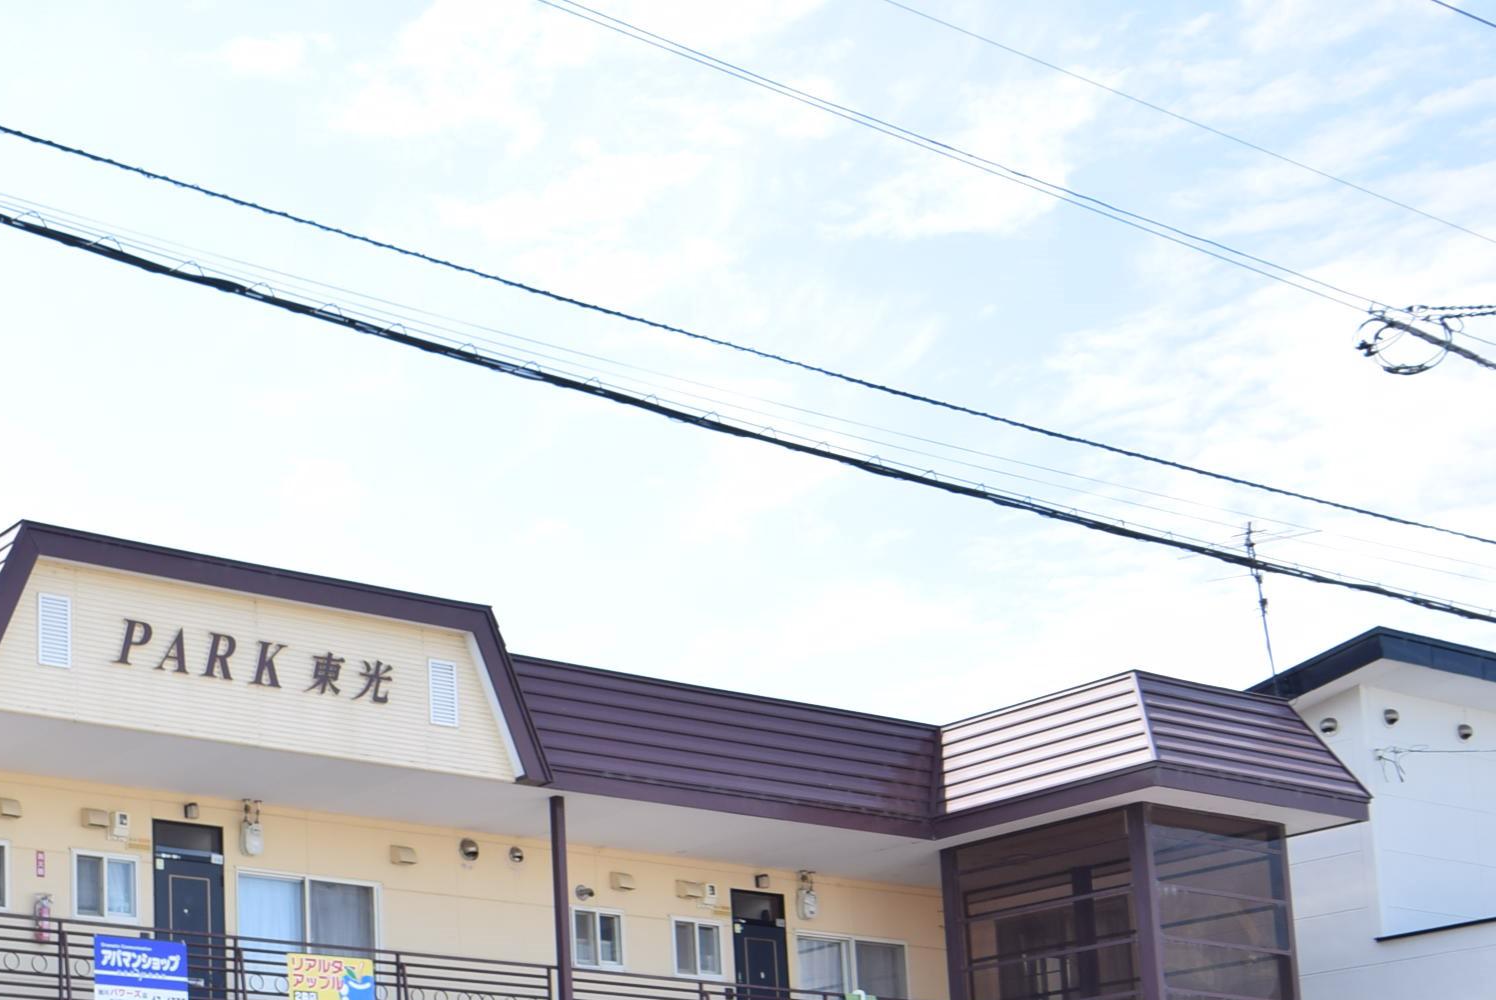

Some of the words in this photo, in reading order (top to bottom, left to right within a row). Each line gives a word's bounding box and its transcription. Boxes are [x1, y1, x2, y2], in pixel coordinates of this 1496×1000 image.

[111, 618, 288, 688] PARK
[303, 652, 393, 704] 東光
[292, 973, 344, 991] アップル
